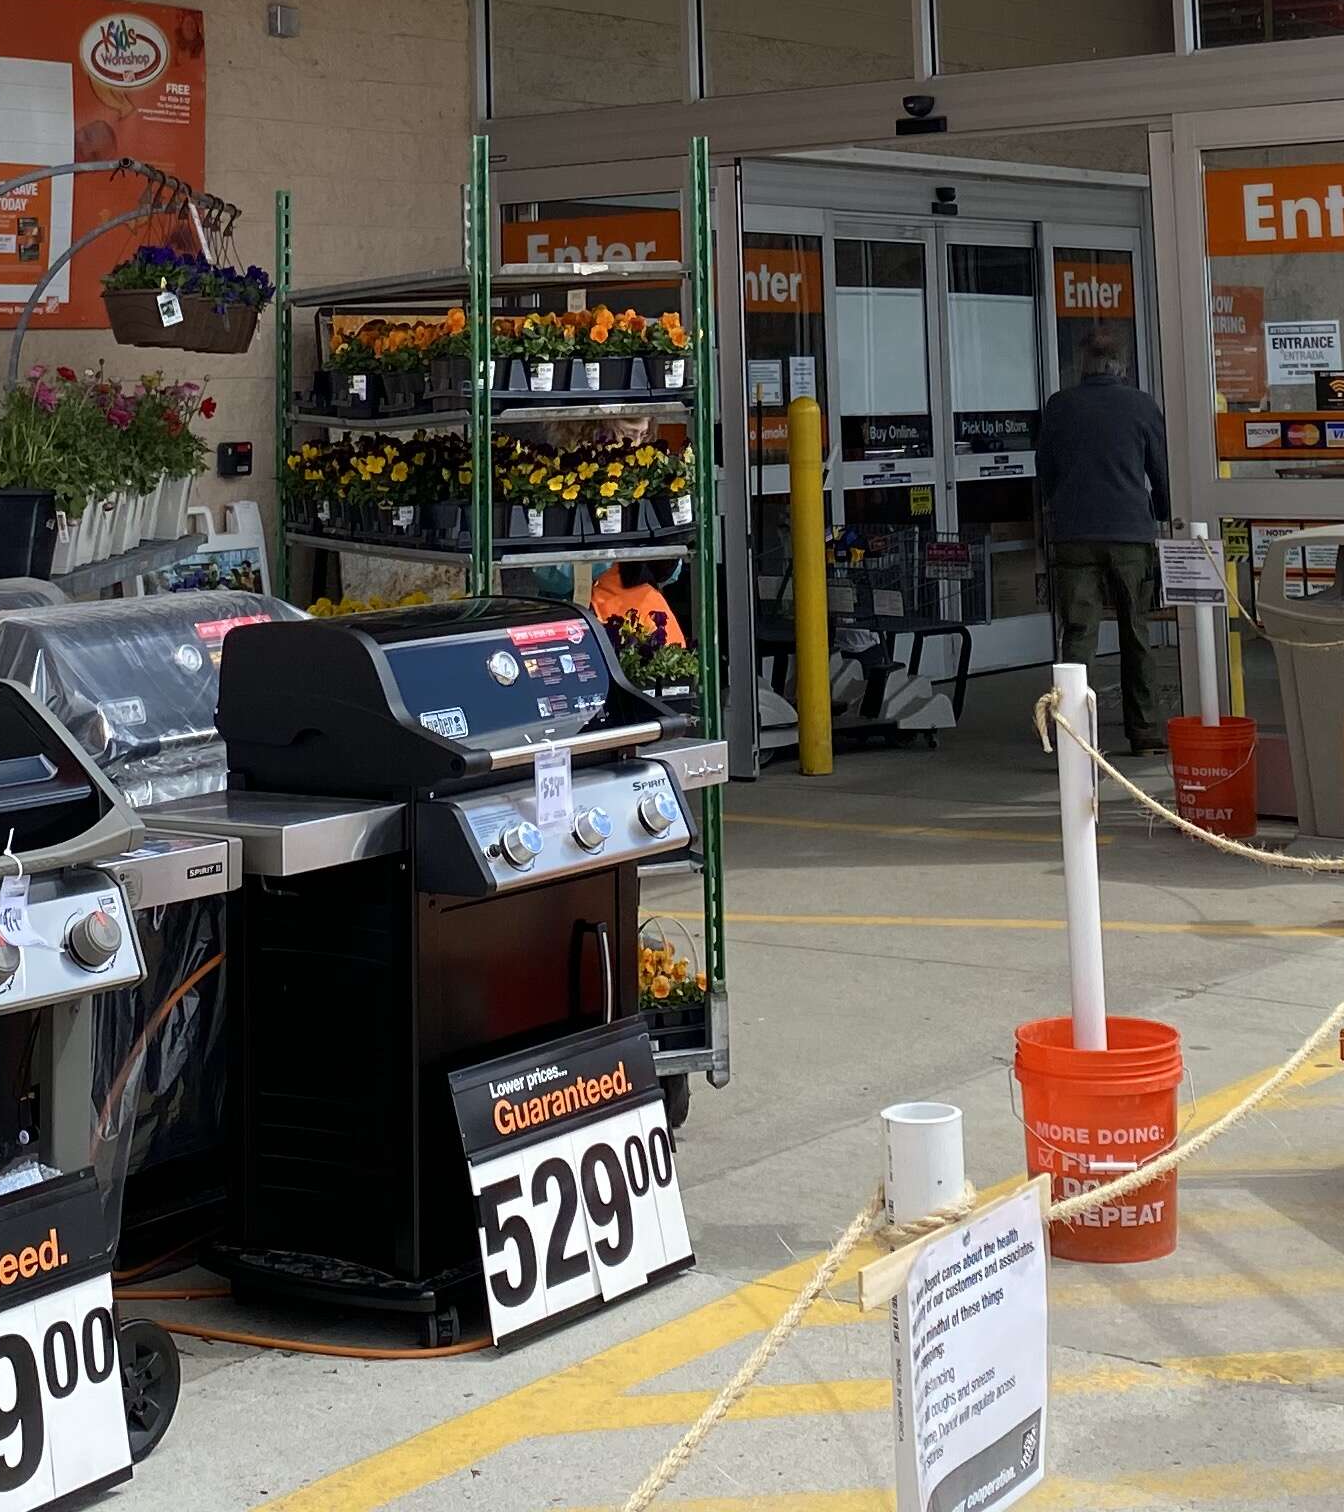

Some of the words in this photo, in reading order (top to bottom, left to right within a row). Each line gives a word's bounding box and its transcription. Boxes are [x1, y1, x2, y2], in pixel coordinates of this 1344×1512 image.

[100, 19, 137, 56] Kids
[101, 52, 150, 67] Workshop
[166, 83, 190, 95] FREE
[526, 234, 656, 263] Enter
[744, 263, 803, 302] nter
[1064, 272, 1122, 308] Enter
[1272, 336, 1334, 350] ENTRANCE
[1283, 350, 1325, 361] ENTRADA
[869, 426, 887, 442] Buy
[889, 425, 920, 439] Online.
[962, 420, 981, 435] Pick
[982, 420, 994, 436] Up
[995, 420, 1004, 433] In
[1005, 420, 1029, 433] Store.
[632, 777, 667, 792] SPIRIT
[488, 1077, 525, 1100] Lower
[526, 1064, 568, 1091] prices...
[494, 1061, 634, 1136] Guaranteed.
[1035, 1121, 1090, 1144] MORE
[1097, 1125, 1165, 1145] DOING:
[941, 1261, 962, 1282] cares
[963, 1247, 983, 1269] about
[983, 1242, 996, 1258] the
[996, 1228, 1019, 1250] health
[945, 1269, 983, 1300] customers
[984, 1258, 997, 1279] and
[926, 1315, 951, 1343] mindful
[951, 1308, 959, 1327] of
[960, 1300, 980, 1321] these
[981, 1287, 1004, 1310] things
[931, 1391, 956, 1420] coughs
[958, 1383, 970, 1402] and
[971, 1366, 996, 1393] sneezes
[938, 1414, 958, 1438] Depot
[959, 1401, 969, 1426] will
[971, 1388, 996, 1418] regulate
[967, 1466, 1016, 1510] cooperation.
